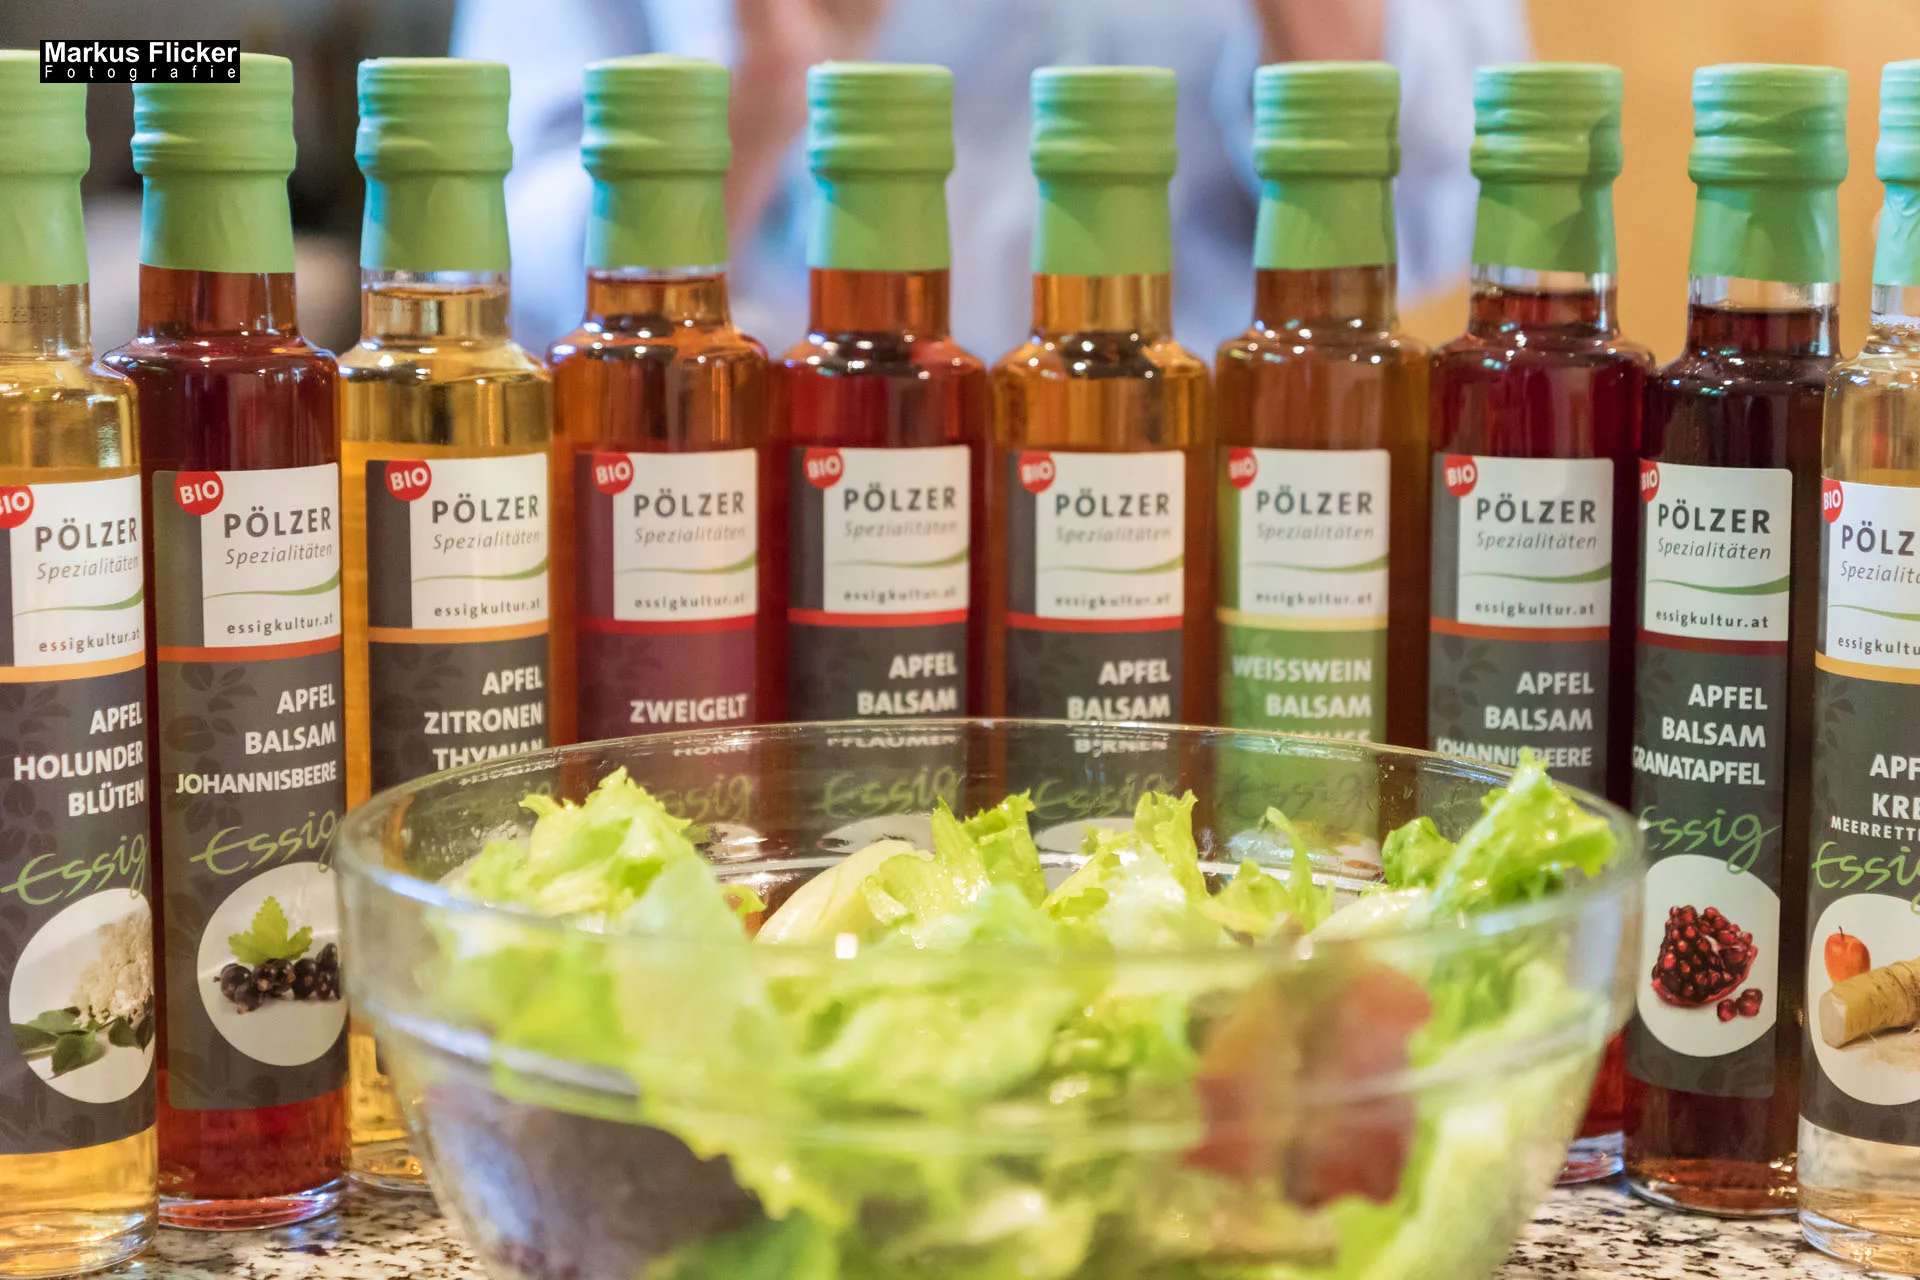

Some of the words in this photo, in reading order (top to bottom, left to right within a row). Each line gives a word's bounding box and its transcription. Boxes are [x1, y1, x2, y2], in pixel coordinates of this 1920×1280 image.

[389, 469, 429, 491] BIO
[595, 462, 631, 485] BIO
[806, 455, 841, 479] BIO
[1446, 463, 1475, 488] BIO
[1641, 469, 1658, 491] BIO
[179, 480, 220, 505] BIO
[632, 488, 745, 519] PÖLZER
[843, 481, 957, 513] PÖLZER
[1055, 488, 1170, 518] PÖLZER
[1256, 484, 1373, 516] PÖLZER
[1823, 489, 1842, 511] BIO
[224, 505, 332, 539] PÖLZER
[431, 493, 539, 525] PÖLZER
[1476, 492, 1597, 524] PÖLZER
[1658, 498, 1771, 534] PÖLZER
[35, 517, 138, 553] PÖLZER
[432, 529, 540, 554] Spezialitäten
[633, 524, 746, 548] Spezialitäten
[1476, 531, 1597, 551] Spezialitäten
[1658, 537, 1771, 560] Spezialitäten
[1841, 520, 1916, 557] PÖLZ
[36, 555, 139, 585] Spezialitäten
[225, 543, 333, 569] Spezialitäten
[433, 600, 541, 619] essigkultur.at
[634, 591, 745, 611] essigkultur.at
[1256, 591, 1373, 608] essigkultur.at
[1475, 601, 1595, 619] essigkultur.at
[227, 612, 334, 637] essigkultur.at
[1656, 609, 1769, 629] essigkultur.at
[39, 628, 140, 654] essigkultur.at
[888, 652, 957, 680] APFEL
[1098, 658, 1172, 686] APFEL
[1232, 655, 1372, 683] WEISSWEIN
[481, 665, 543, 696] APFEL
[1516, 671, 1595, 695] APFEL
[276, 683, 336, 714] APFEL
[629, 693, 748, 724] ZWEIGELT
[857, 686, 957, 715] BALSAM
[1067, 693, 1171, 720] BALSAM
[1265, 693, 1372, 719] BALSAM
[1687, 683, 1768, 710] APFEL
[89, 700, 143, 735] APFEL
[423, 702, 543, 735] ZITRONEN
[1484, 705, 1593, 731] BALSAM
[245, 720, 337, 755] BALSAM
[1661, 716, 1767, 748] BALSAM
[13, 740, 144, 781] HOLUNDER
[1436, 737, 1593, 767] JOHANNIBEERE
[176, 760, 337, 794] JOHANNISBEERE
[68, 779, 145, 817] BLÜTEN
[189, 809, 340, 875] Essig
[1830, 815, 1920, 842] MEERRETT
[0, 833, 148, 905] Essig
